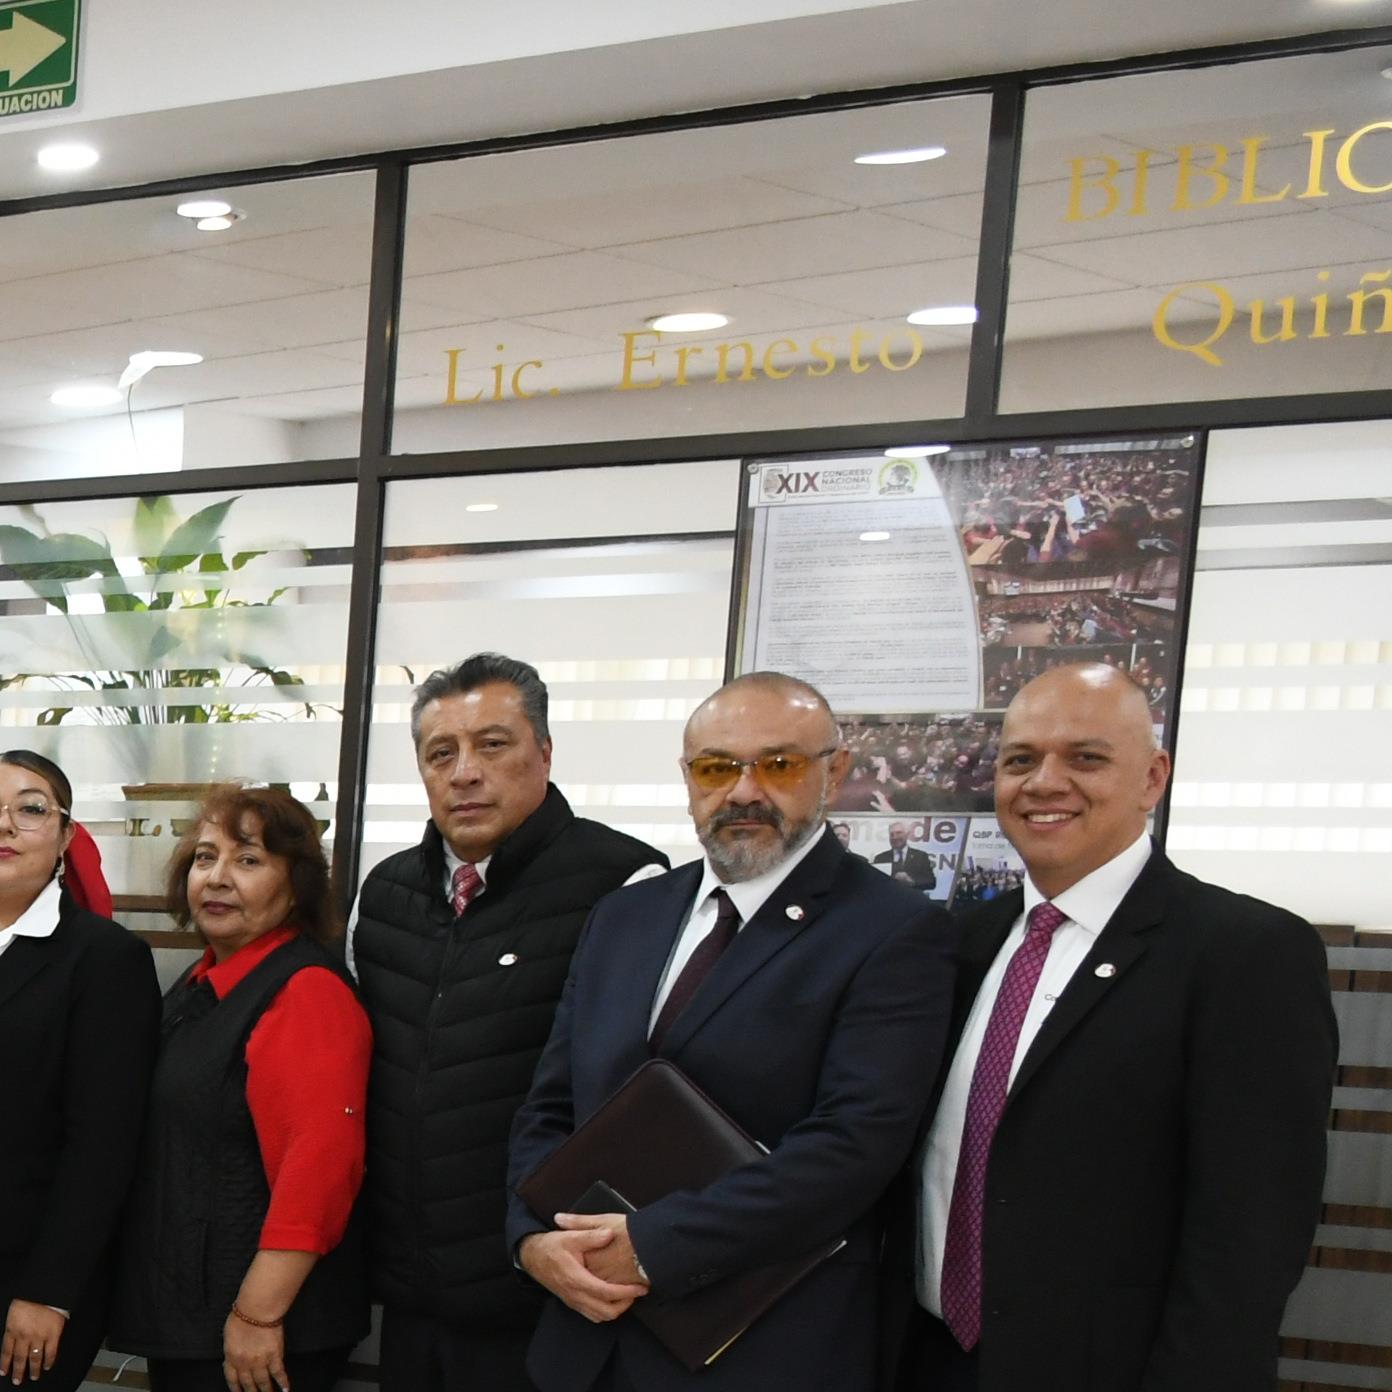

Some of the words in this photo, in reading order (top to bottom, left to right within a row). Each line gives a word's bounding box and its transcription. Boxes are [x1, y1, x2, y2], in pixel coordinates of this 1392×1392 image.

[442, 344, 561, 407] Lic.
[615, 324, 924, 392] Ernesto
[776, 471, 820, 494] XIX
[910, 815, 957, 843] de
